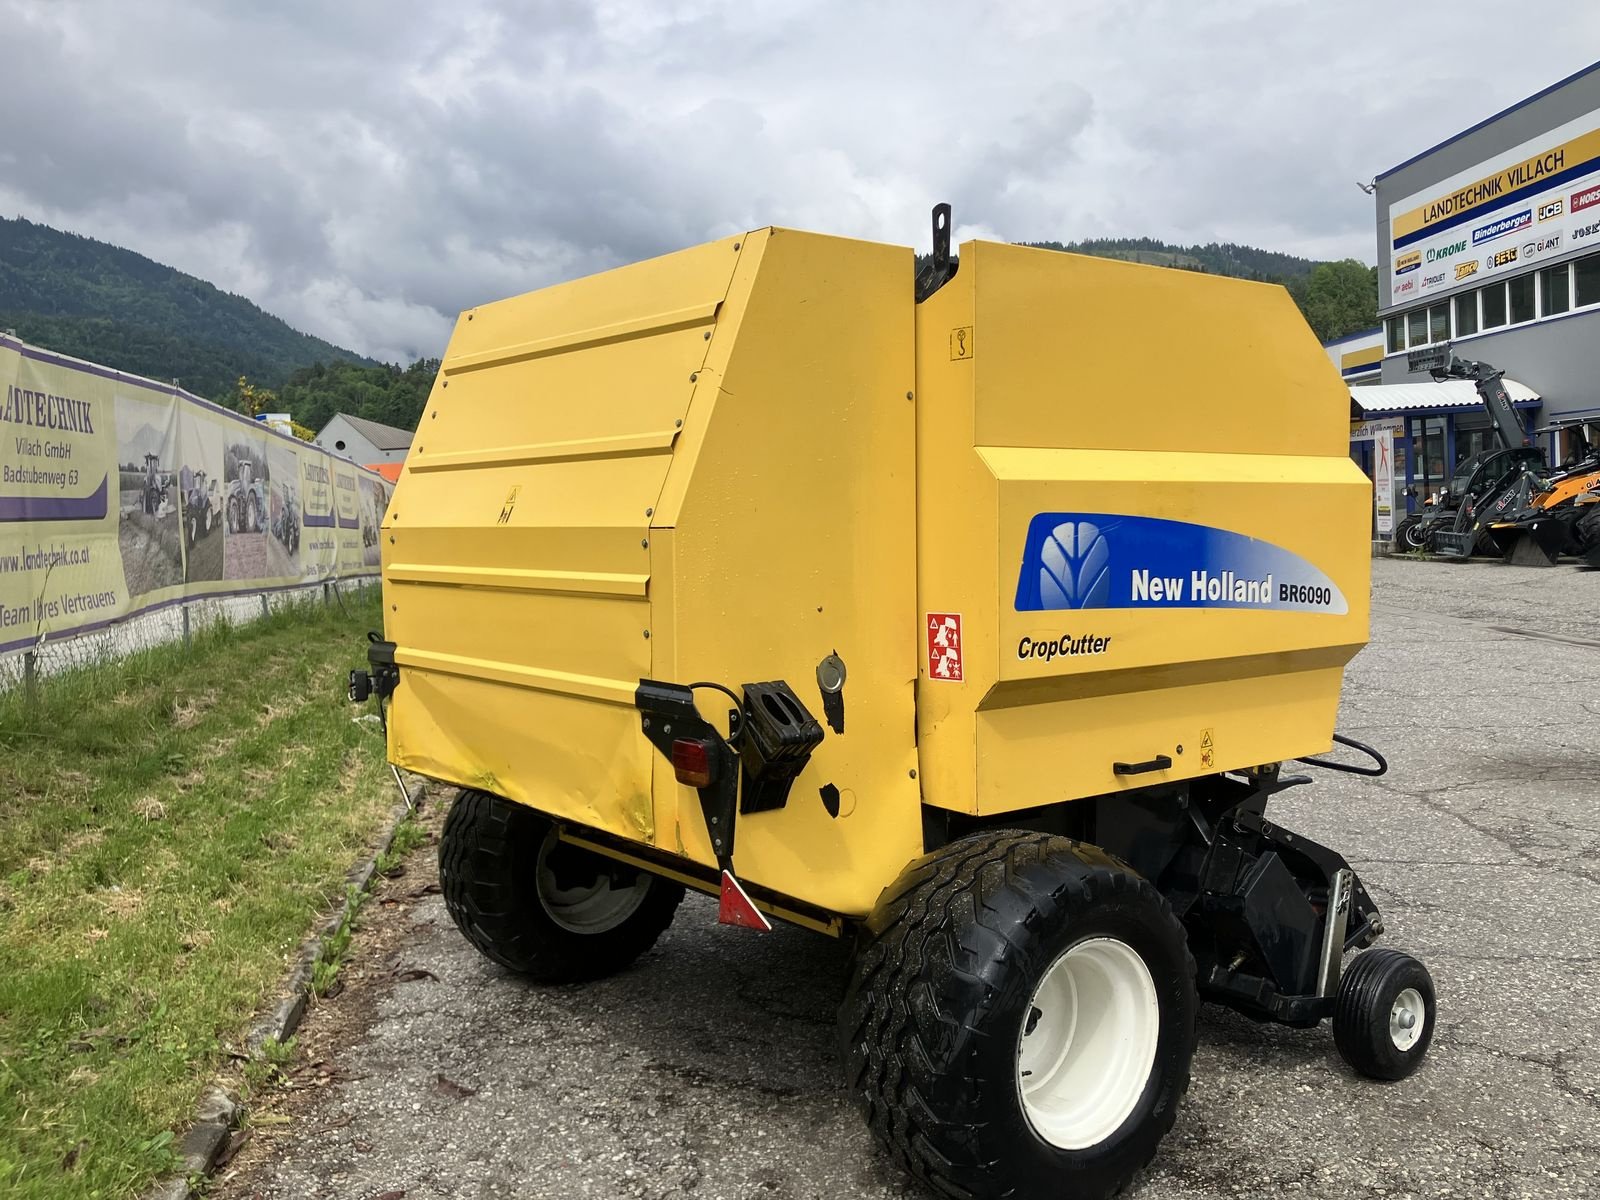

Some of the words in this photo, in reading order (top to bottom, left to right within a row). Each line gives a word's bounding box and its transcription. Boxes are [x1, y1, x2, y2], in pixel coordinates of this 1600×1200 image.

[1424, 176, 1502, 223] LANDTECHNIK
[1507, 149, 1564, 188] VILLACH
[1539, 201, 1562, 220] JCB
[1474, 213, 1530, 240] Binderberger
[1436, 240, 1467, 260] KRONE
[1401, 280, 1413, 291] aebi
[44, 441, 71, 459] GmbH
[4, 465, 65, 489] Badstubenweg
[69, 470, 79, 485] 63
[1131, 569, 1183, 601] New
[1191, 570, 1272, 603] Holland
[1279, 583, 1331, 605] BR6090
[33, 597, 59, 621] Ihres
[60, 591, 116, 615] Vertrauens
[1018, 634, 1111, 662] CropCutter
